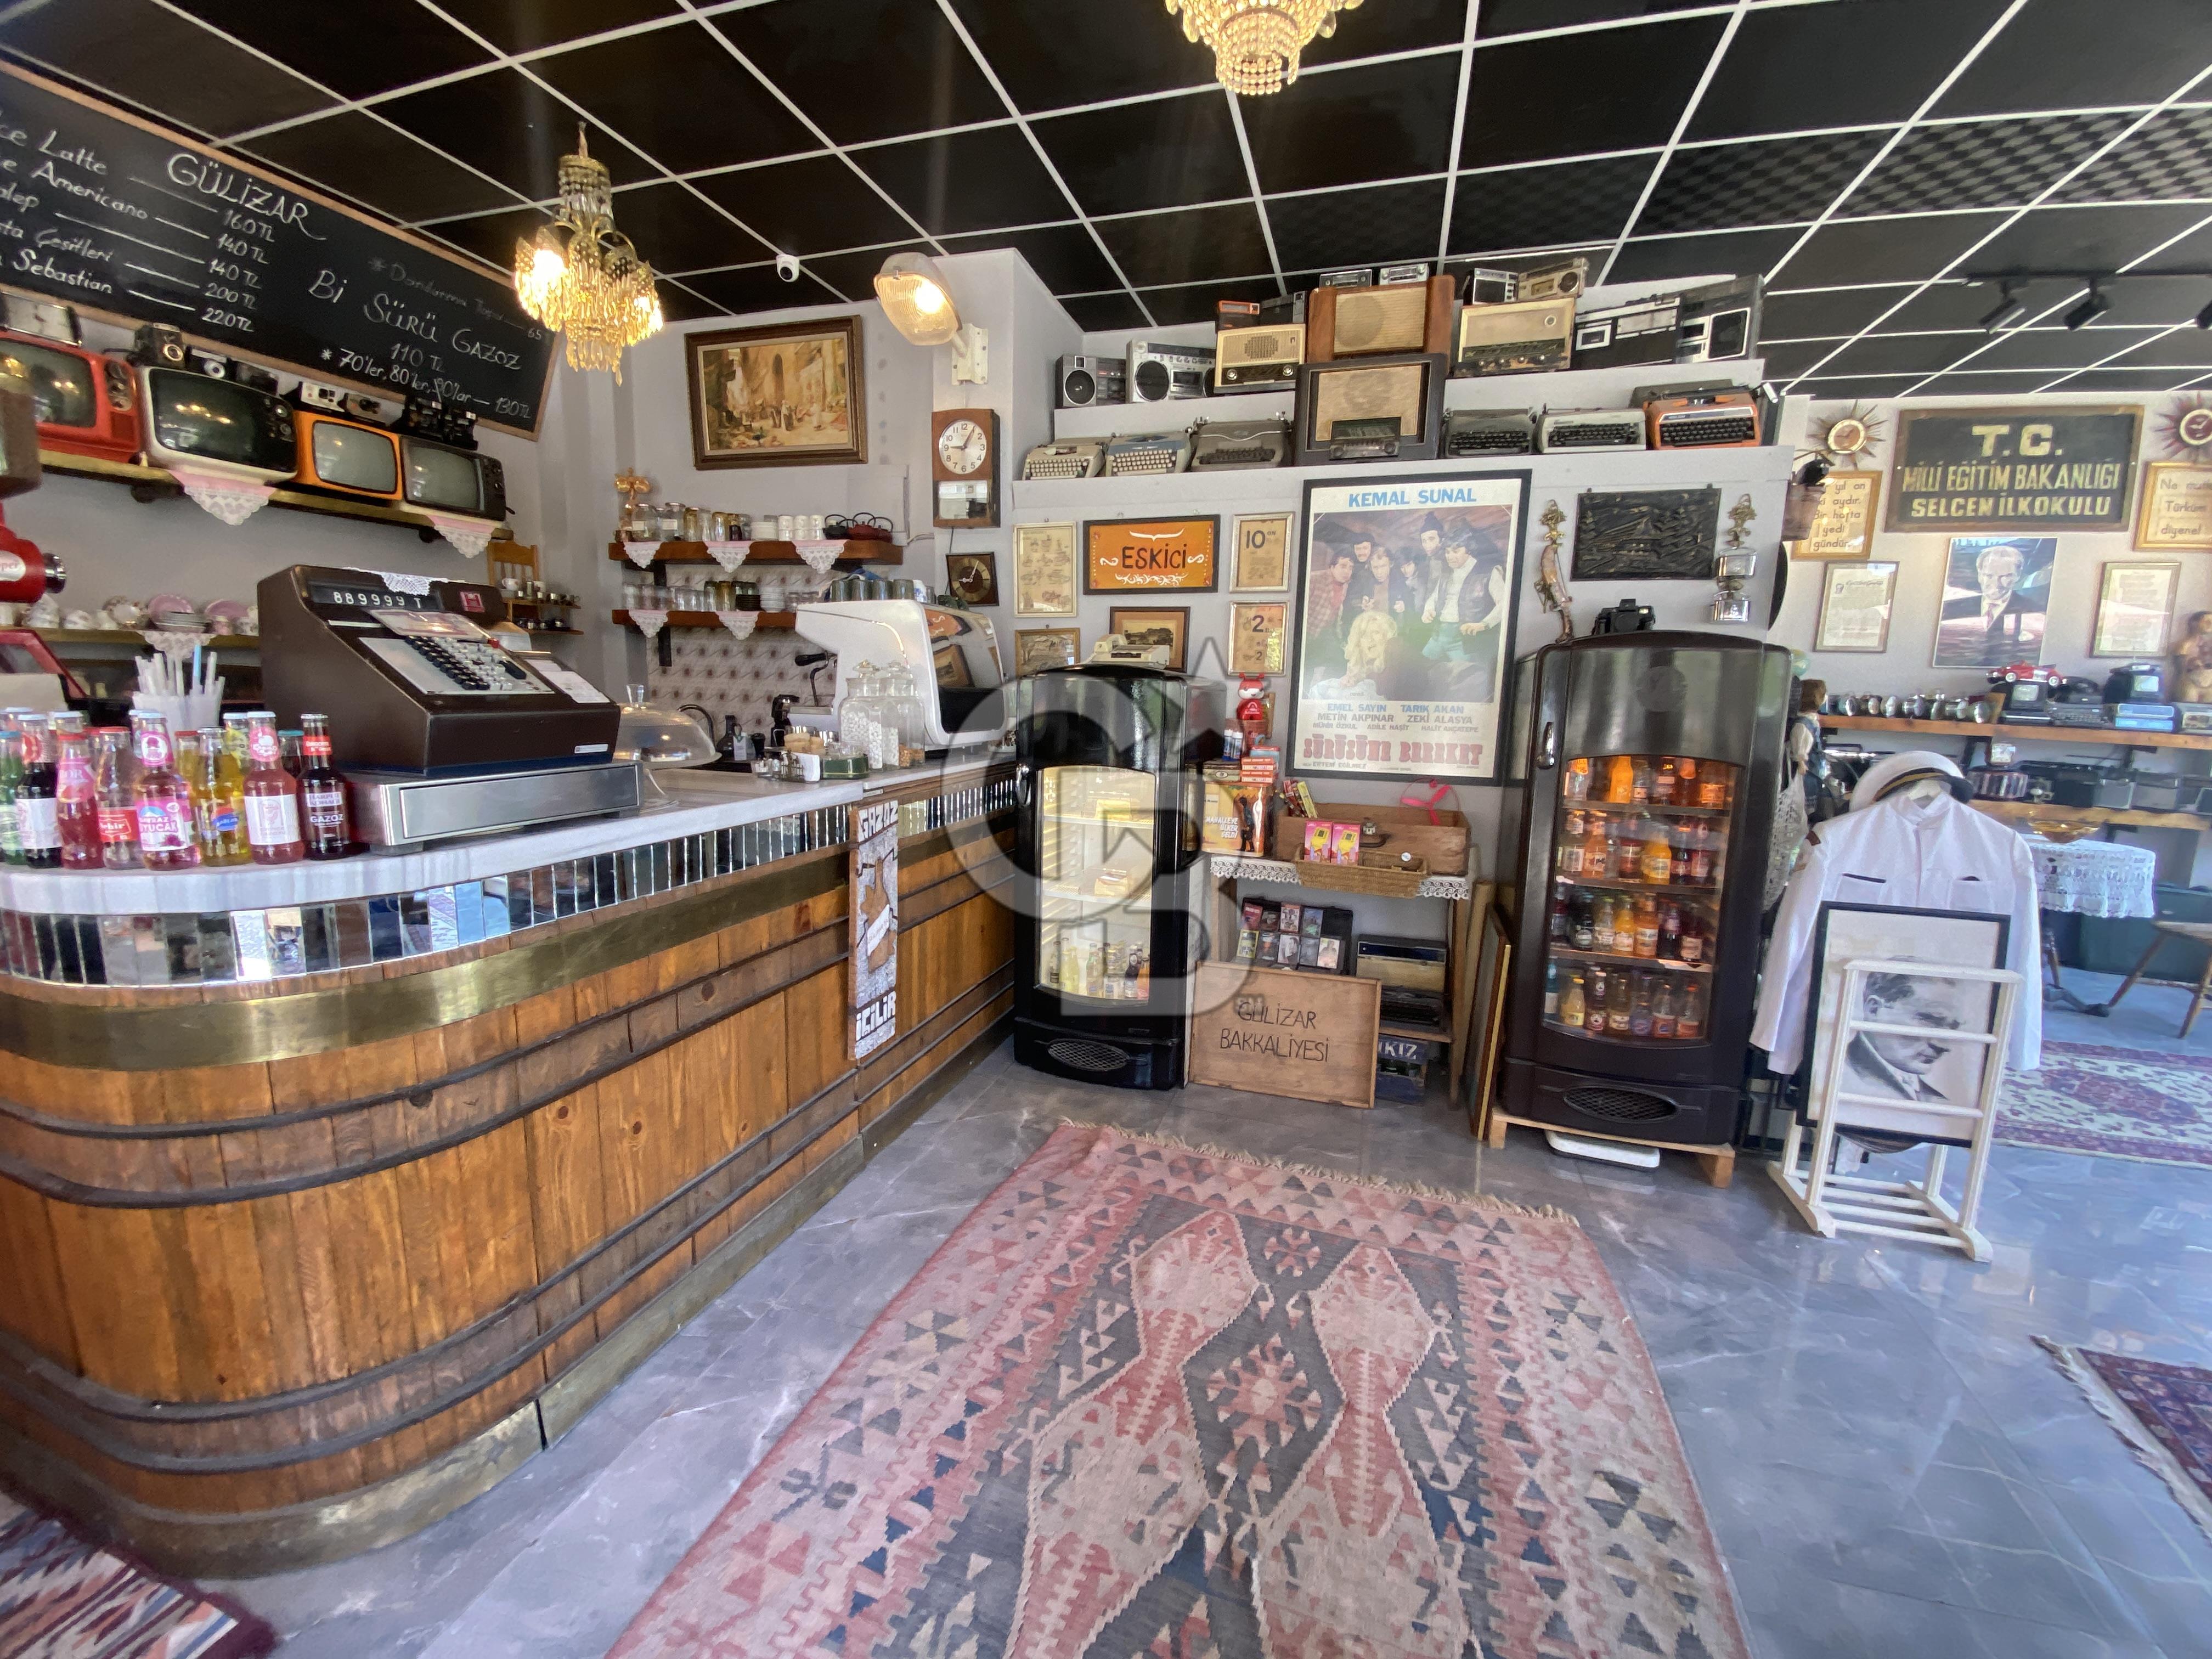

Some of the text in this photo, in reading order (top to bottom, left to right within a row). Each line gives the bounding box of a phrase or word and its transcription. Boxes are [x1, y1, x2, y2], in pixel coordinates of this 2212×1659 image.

[38, 129, 108, 175] Latte
[30, 161, 149, 220] Americano
[167, 153, 327, 240] GÜLİZAR
[13, 248, 112, 294] Sebastian
[308, 269, 348, 304] Bi
[391, 342, 424, 366] 110
[1835, 480, 1846, 494] yıl
[1902, 458, 2121, 492] MİLLİ EĞİTİM BAKANLIĞI
[1348, 488, 1477, 507] KEMAL SUNAL
[1911, 492, 2112, 517] SELCEN İLKOKULU
[1246, 530, 1266, 549] 10
[1122, 543, 1188, 570] ESKİCİ
[1252, 614, 1265, 633] 2
[1317, 712, 1473, 724] METİN AKPINAR ZEKİ ALASYA
[1328, 703, 1464, 714] EMEL SAYIN TARIK AKAN
[310, 814, 345, 823] GAZOZ
[857, 799, 899, 843] GAZOZ
[1220, 1028, 1329, 1063] BAKKALİYESİ
